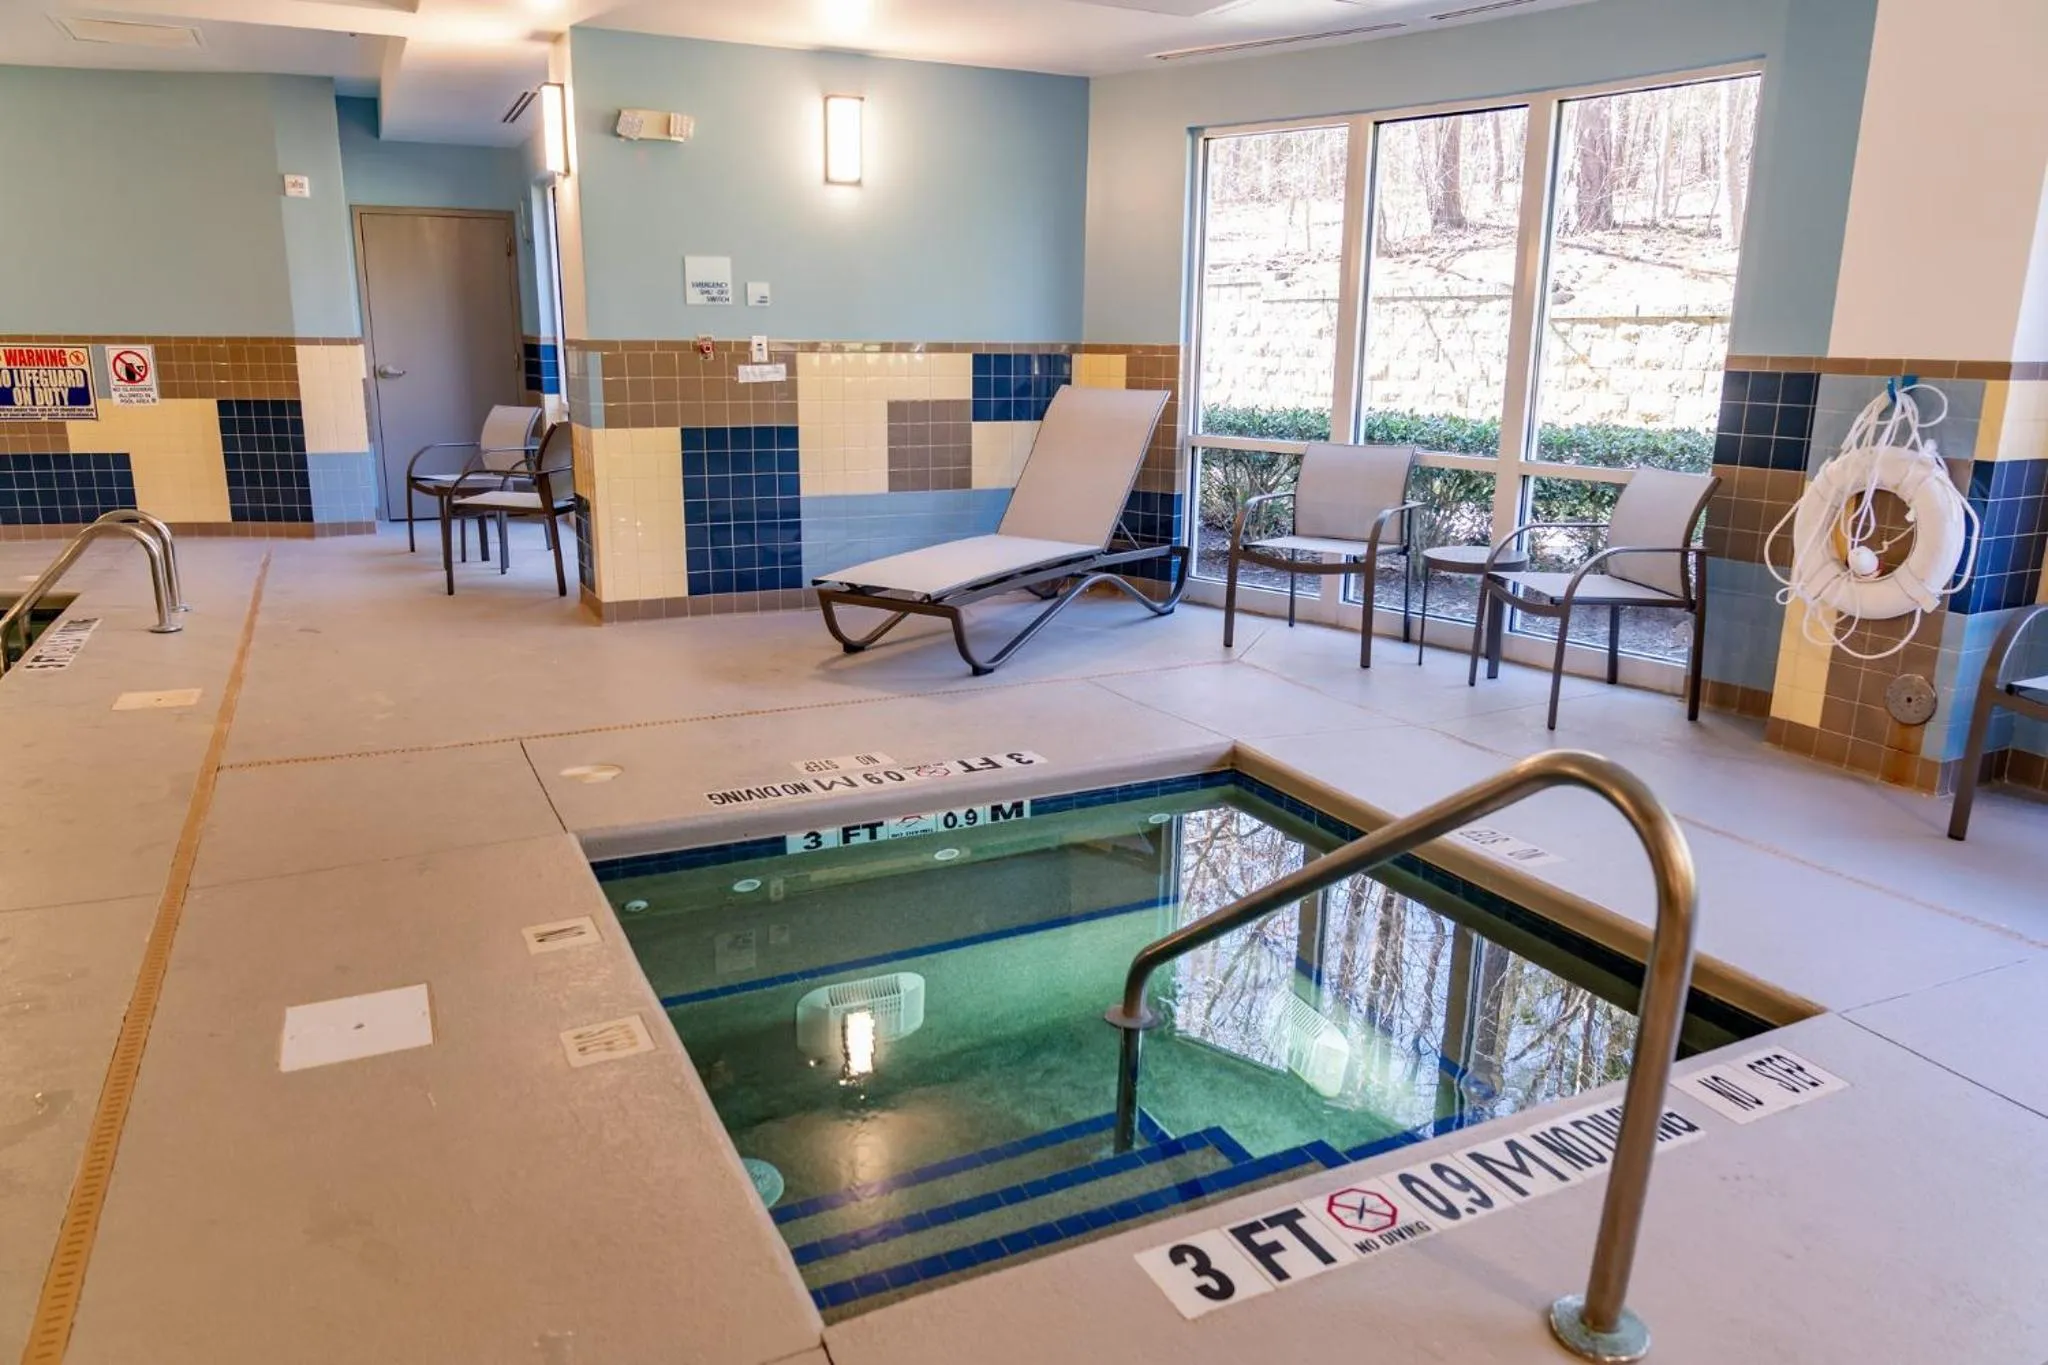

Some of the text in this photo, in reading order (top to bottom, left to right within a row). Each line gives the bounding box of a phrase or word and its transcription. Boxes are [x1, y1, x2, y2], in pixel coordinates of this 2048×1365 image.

[3, 349, 68, 367] WARNING
[0, 369, 85, 388] O LIFEGUARD
[13, 387, 69, 406] ON DUTY
[805, 759, 840, 773] STEP
[957, 757, 1003, 773] FT
[1006, 752, 1035, 766] 3
[780, 781, 812, 796] NO
[813, 775, 859, 791] M
[707, 785, 783, 806] DIVING
[803, 830, 823, 851] 3
[842, 821, 884, 845] FT
[943, 808, 978, 829] 0.9
[990, 801, 1024, 821] M
[1697, 1053, 1825, 1111] NO STEP
[1168, 1243, 1236, 1301] 3
[1228, 1207, 1338, 1282] FT
[1398, 1163, 1495, 1221] 0.9
[1466, 1138, 1572, 1198] M
[1530, 1126, 1608, 1172] NO
[1354, 1220, 1431, 1254] NO DIVING
